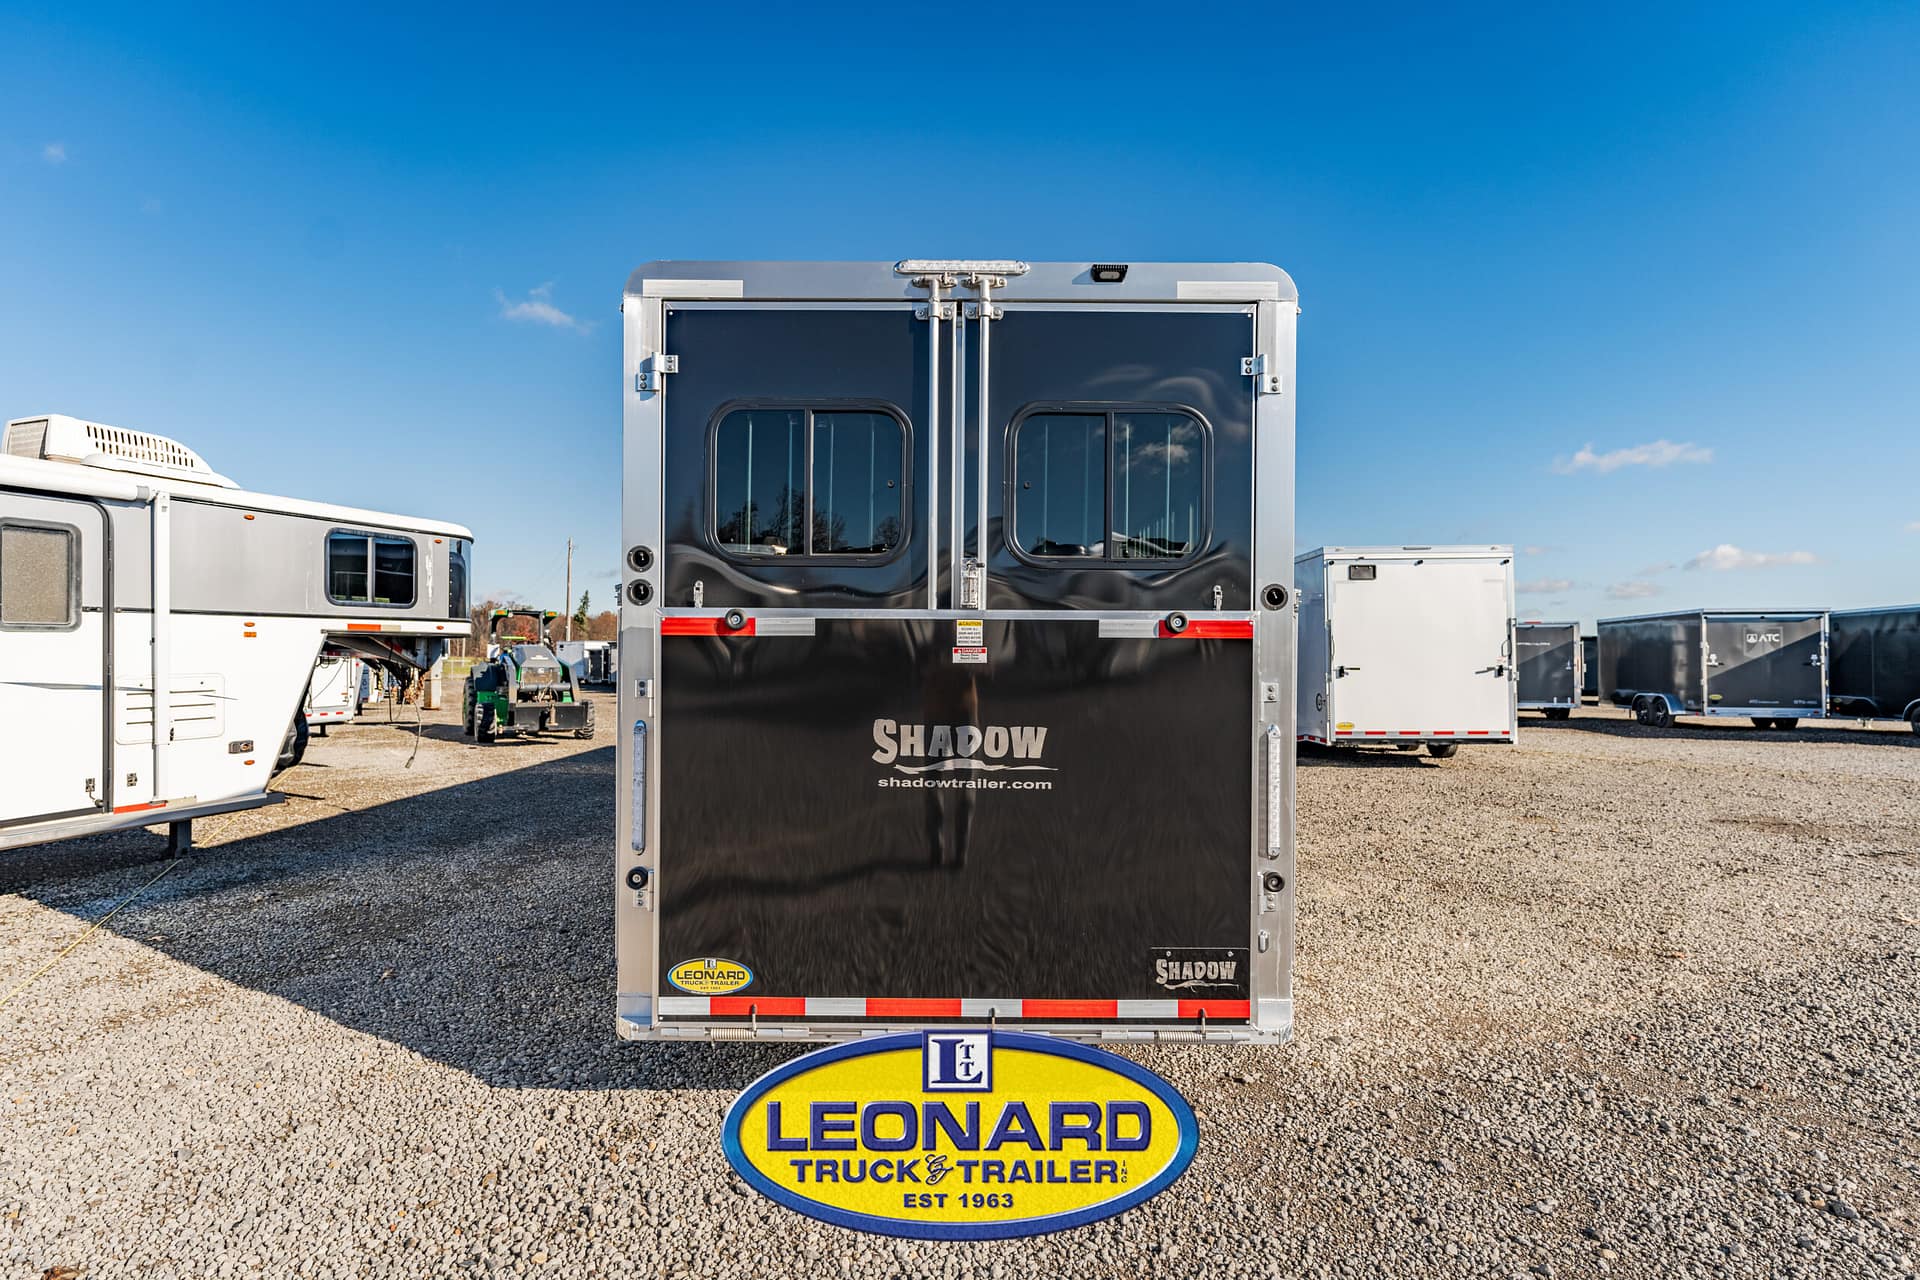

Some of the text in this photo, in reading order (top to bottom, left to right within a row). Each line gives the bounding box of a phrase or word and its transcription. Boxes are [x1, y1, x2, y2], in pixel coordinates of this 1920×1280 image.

[1758, 633, 1780, 642] ATC
[872, 718, 1048, 764] SHADOW
[877, 777, 1053, 790] shadowtrailer.com
[676, 970, 746, 980] LEONARD
[1155, 958, 1237, 984] SHADOW
